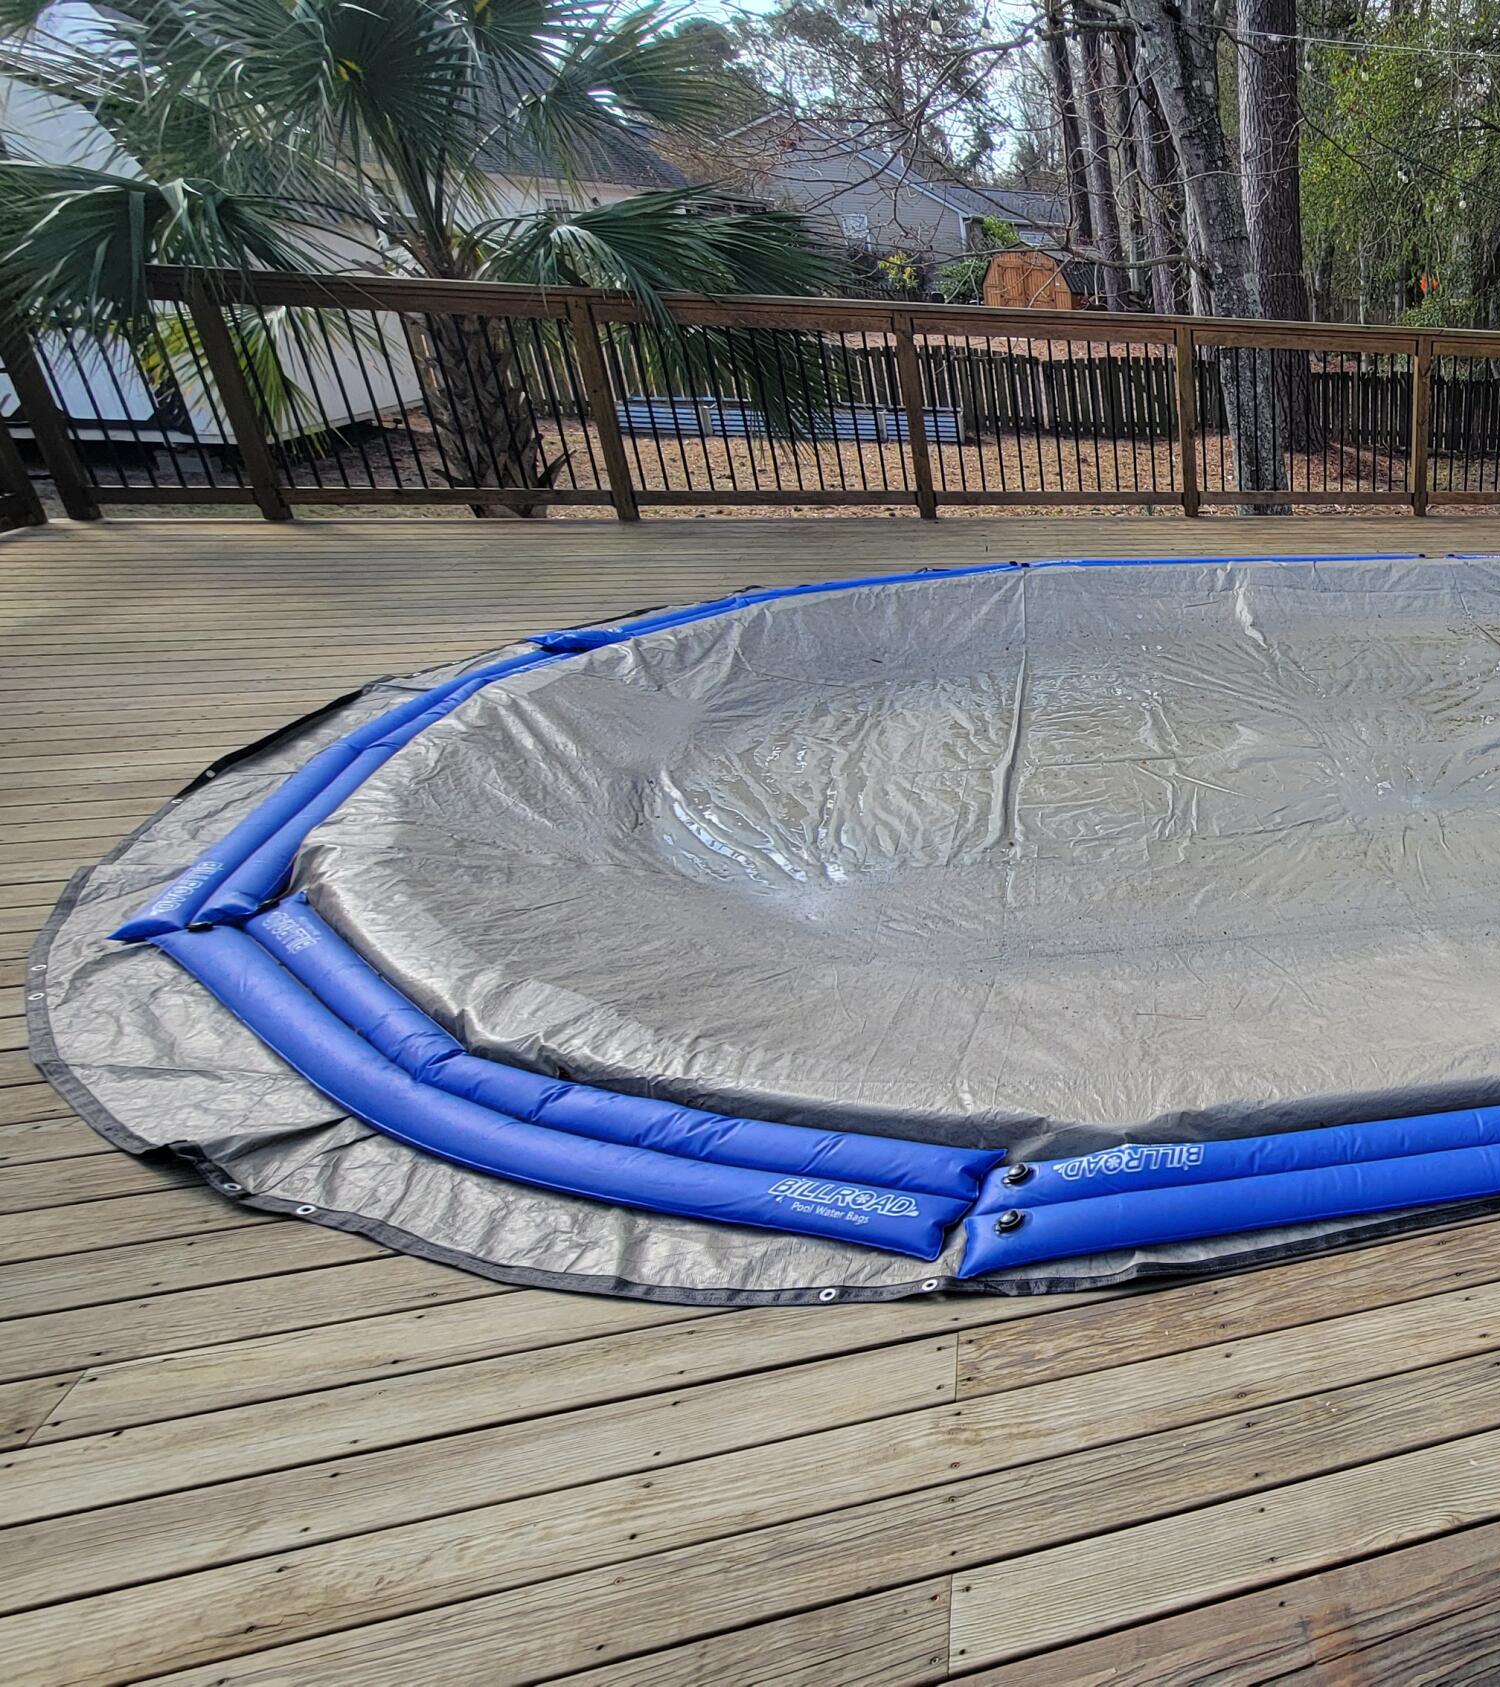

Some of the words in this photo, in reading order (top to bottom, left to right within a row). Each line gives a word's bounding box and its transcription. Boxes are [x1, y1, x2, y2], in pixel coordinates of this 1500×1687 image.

[1060, 1144, 1204, 1180] BILLROAD
[768, 1178, 917, 1216] BILLROAD
[791, 1201, 813, 1213] Pool
[816, 1207, 845, 1219] Water
[845, 1212, 870, 1225] Bags
